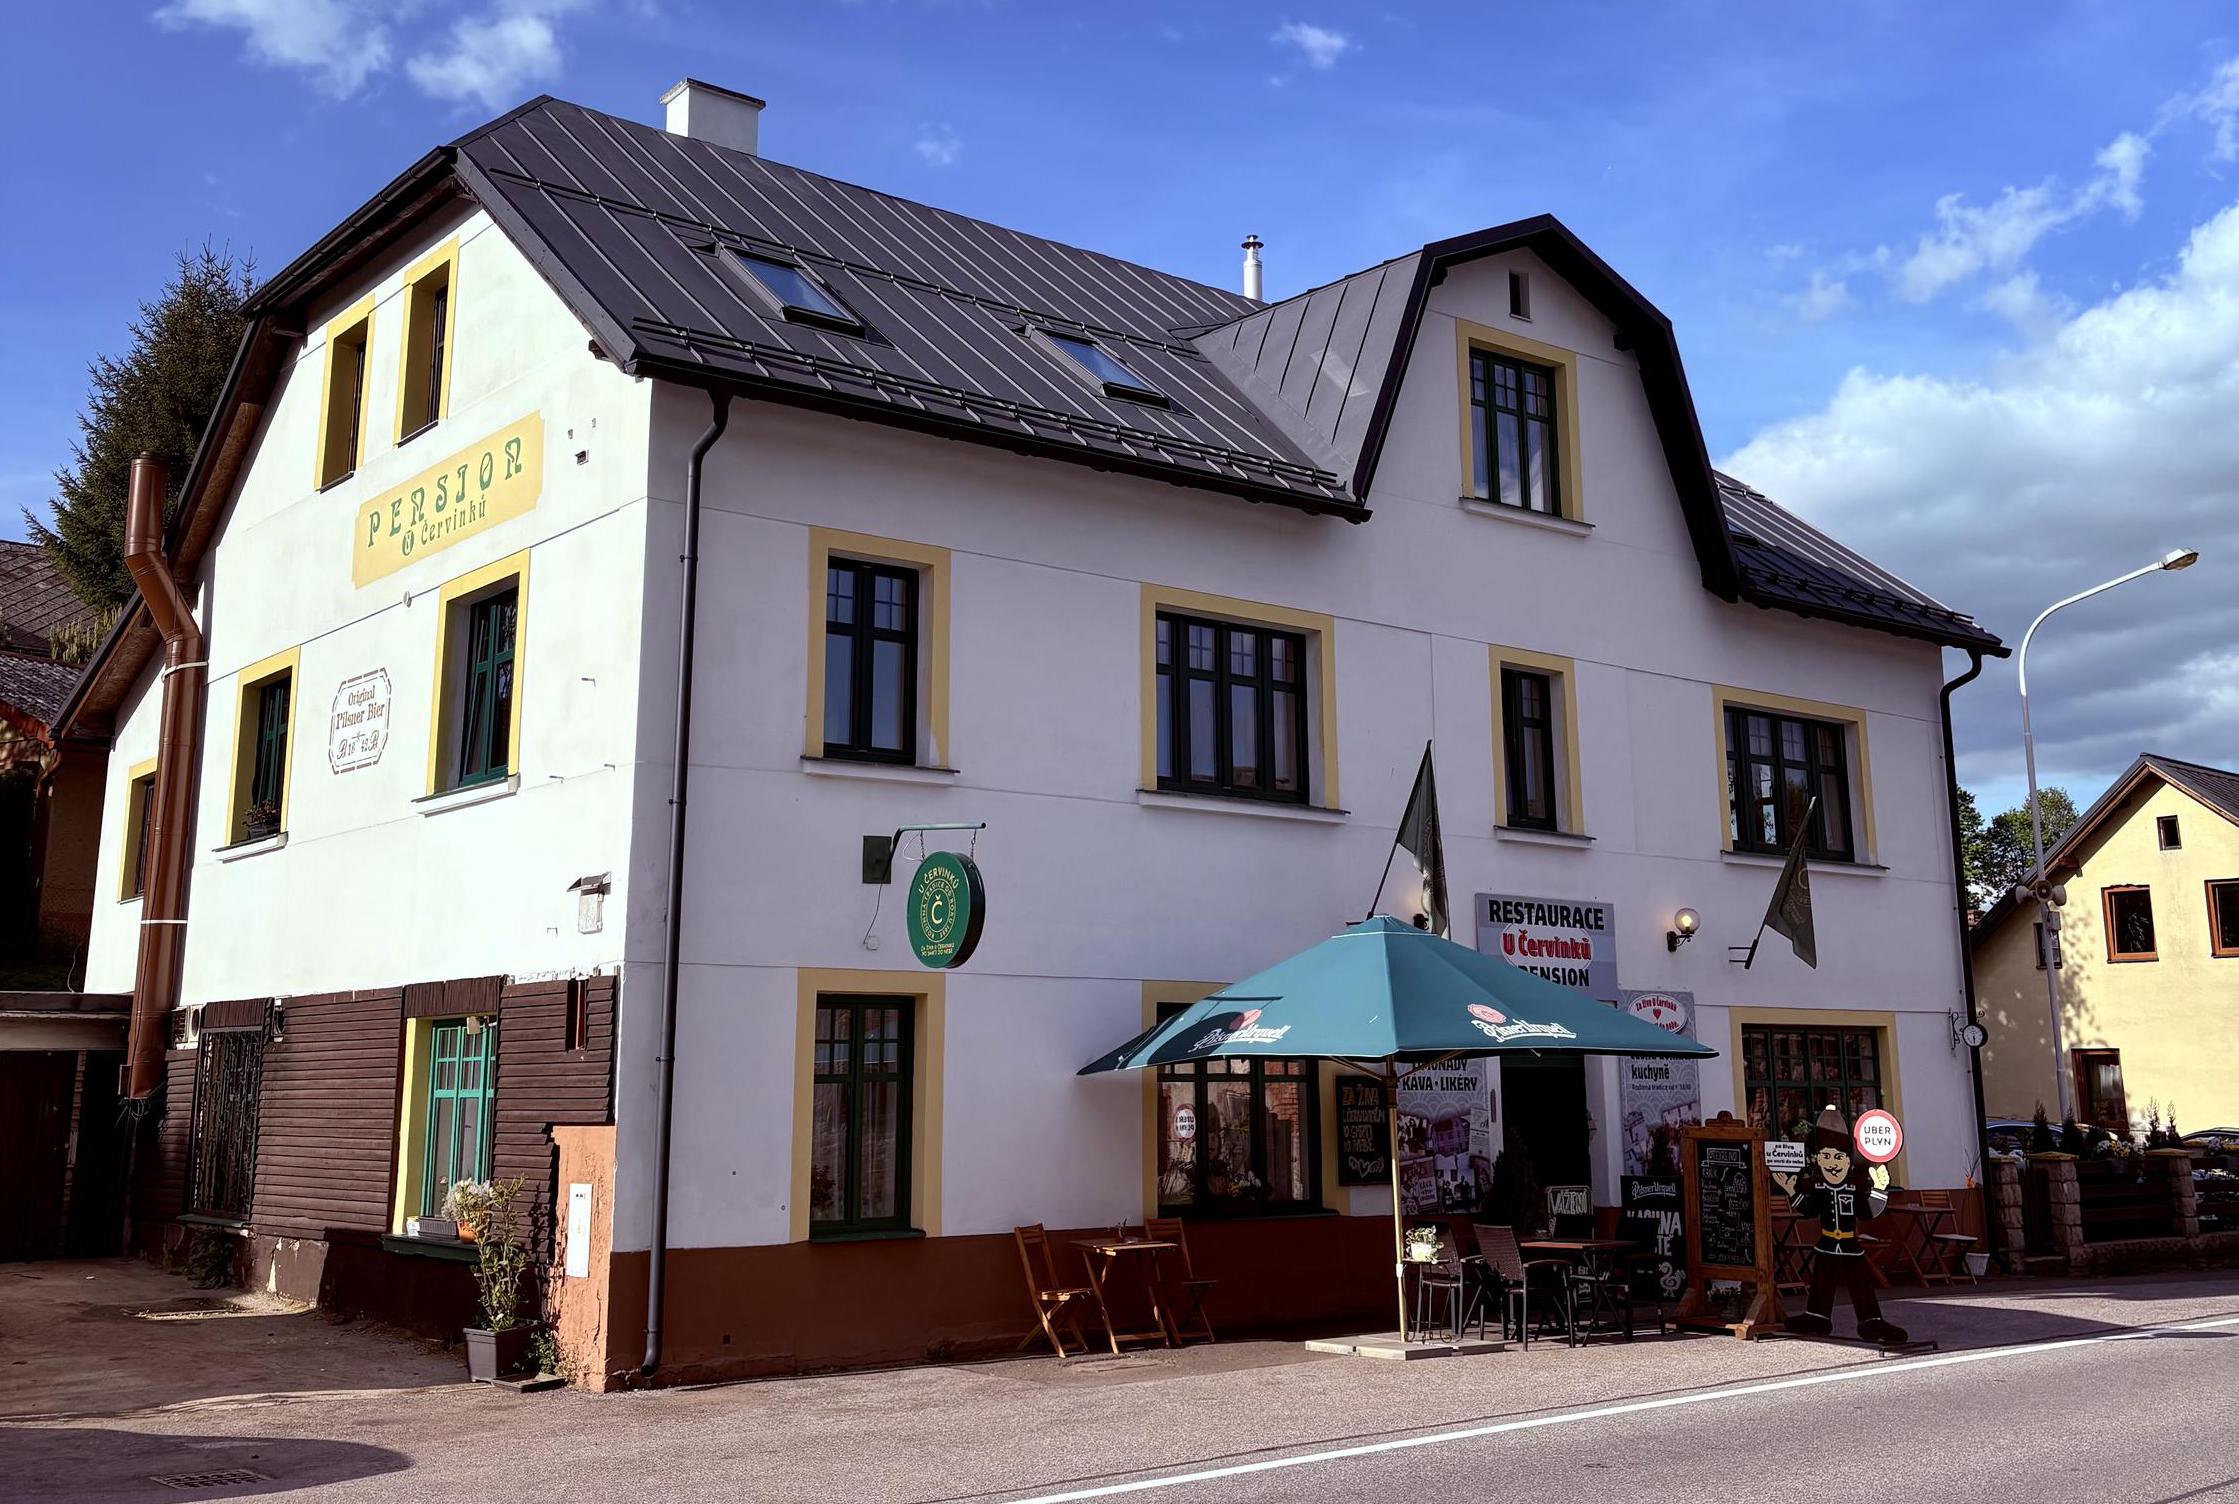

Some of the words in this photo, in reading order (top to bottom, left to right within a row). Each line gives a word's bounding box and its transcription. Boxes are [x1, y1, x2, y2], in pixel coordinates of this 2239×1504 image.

[368, 437, 522, 548] PENSION
[348, 685, 376, 707] Original
[335, 710, 366, 731] Pilsner
[366, 702, 386, 722] Bier
[1488, 899, 1605, 931] RESTAURACE
[1502, 932, 1516, 956] U
[1518, 928, 1593, 961] Červinků
[1402, 1073, 1434, 1092] KÁVA
[1440, 1073, 1478, 1092] LIKÉRY
[1631, 1063, 1670, 1082] kuchyně
[1863, 1126, 1891, 1135] UBER
[1864, 1137, 1891, 1146] PLYN
